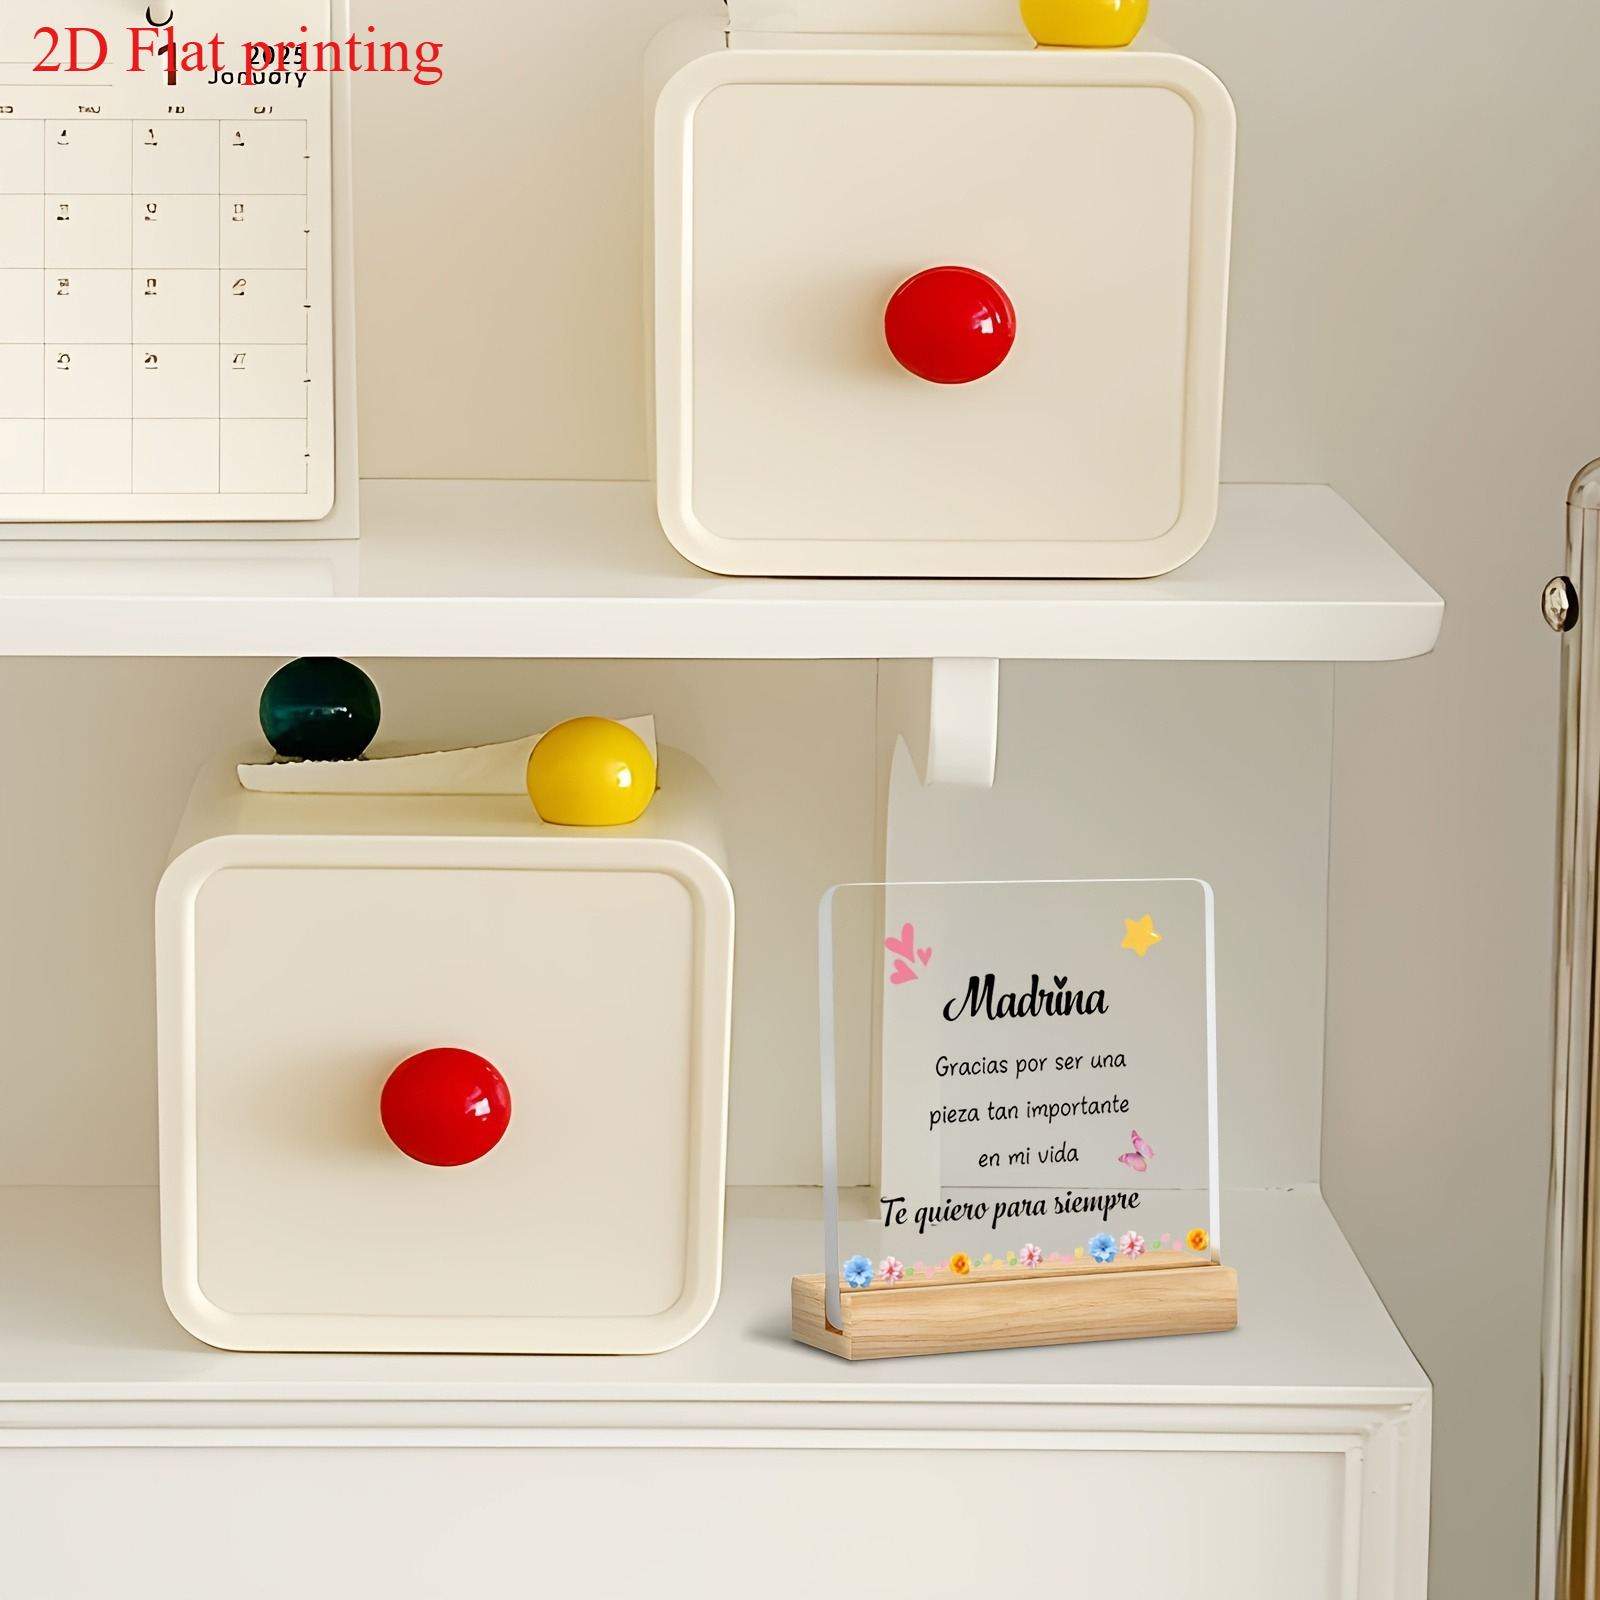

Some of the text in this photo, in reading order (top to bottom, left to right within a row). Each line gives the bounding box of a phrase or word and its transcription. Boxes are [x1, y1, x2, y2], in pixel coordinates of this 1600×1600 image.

[248, 45, 305, 65] 2025
[942, 973, 1110, 1022] Madrina
[935, 1053, 1127, 1079] Gracias por ser una
[929, 1094, 1130, 1131] pieza tan importante
[978, 1140, 1079, 1168] en mi vida
[880, 1190, 1141, 1235] Te quiero para siempre
